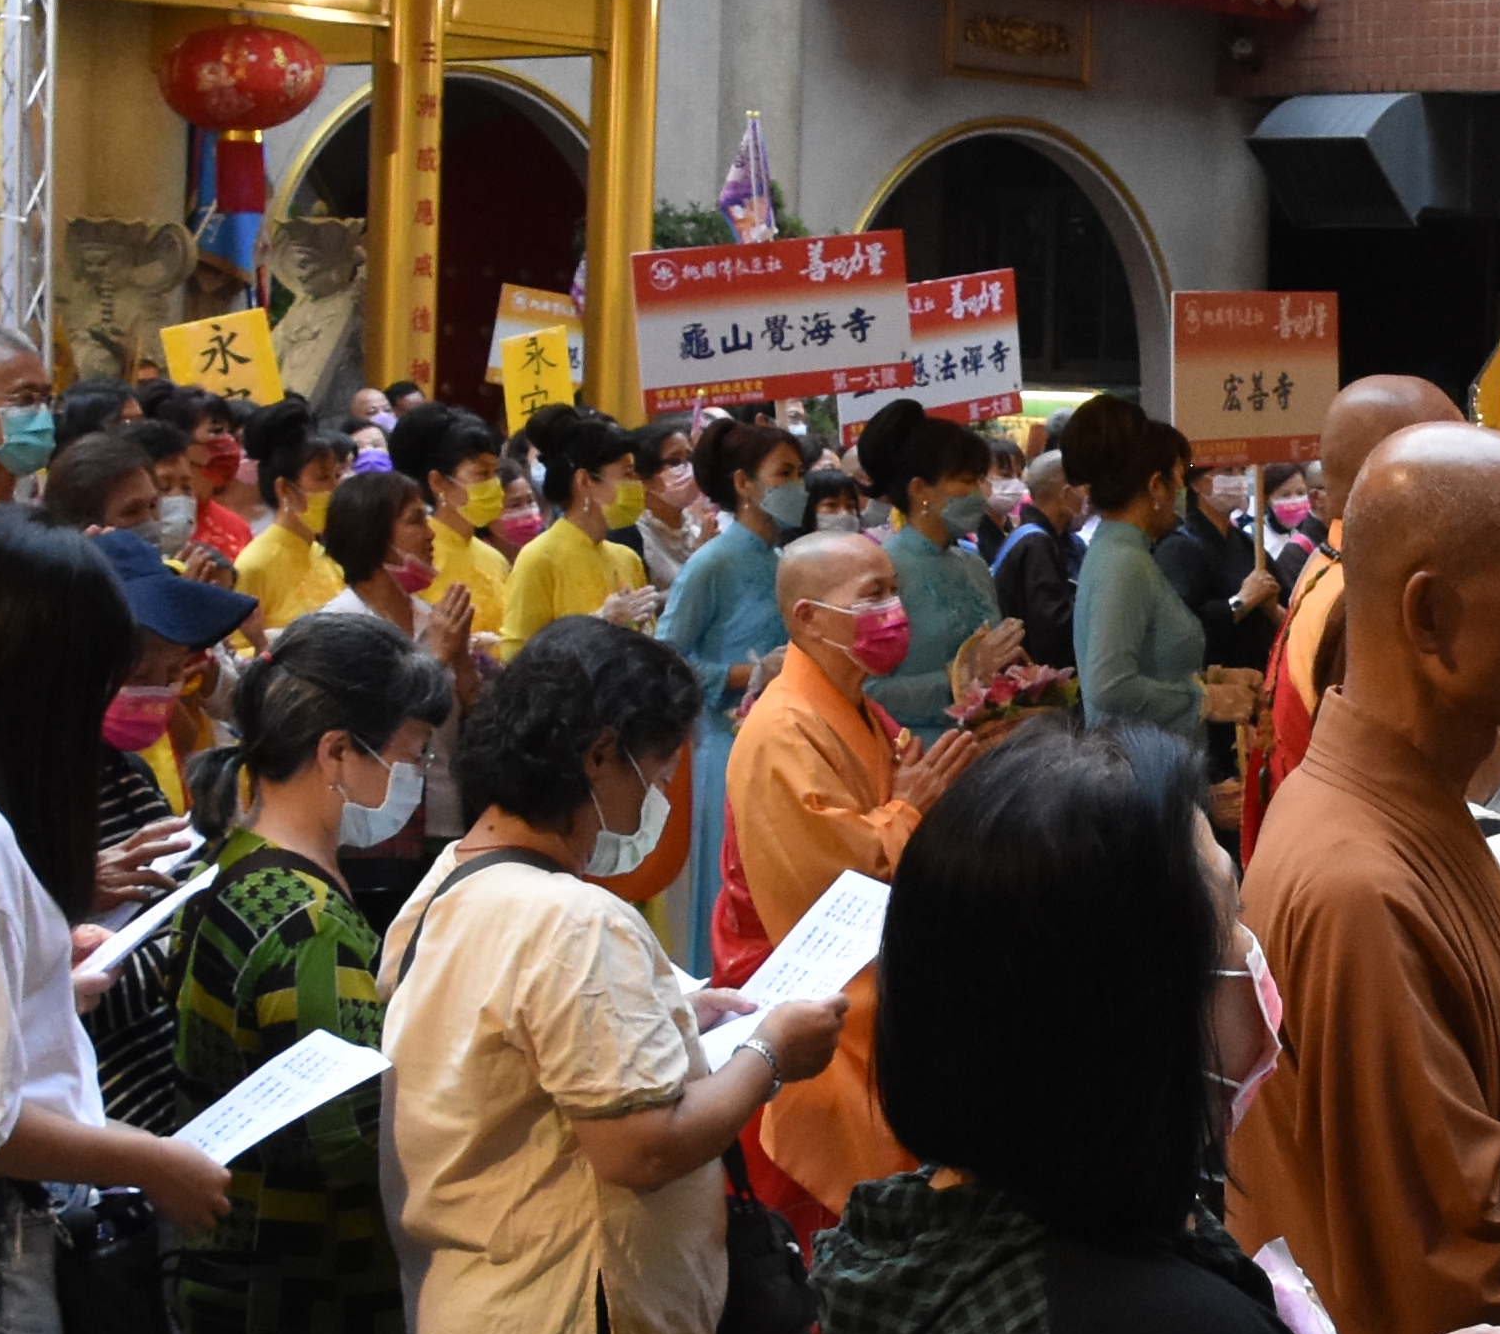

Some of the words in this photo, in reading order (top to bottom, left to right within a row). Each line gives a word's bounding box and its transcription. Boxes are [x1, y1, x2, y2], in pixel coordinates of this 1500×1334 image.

[679, 307, 877, 361] 龜山覺海寺
